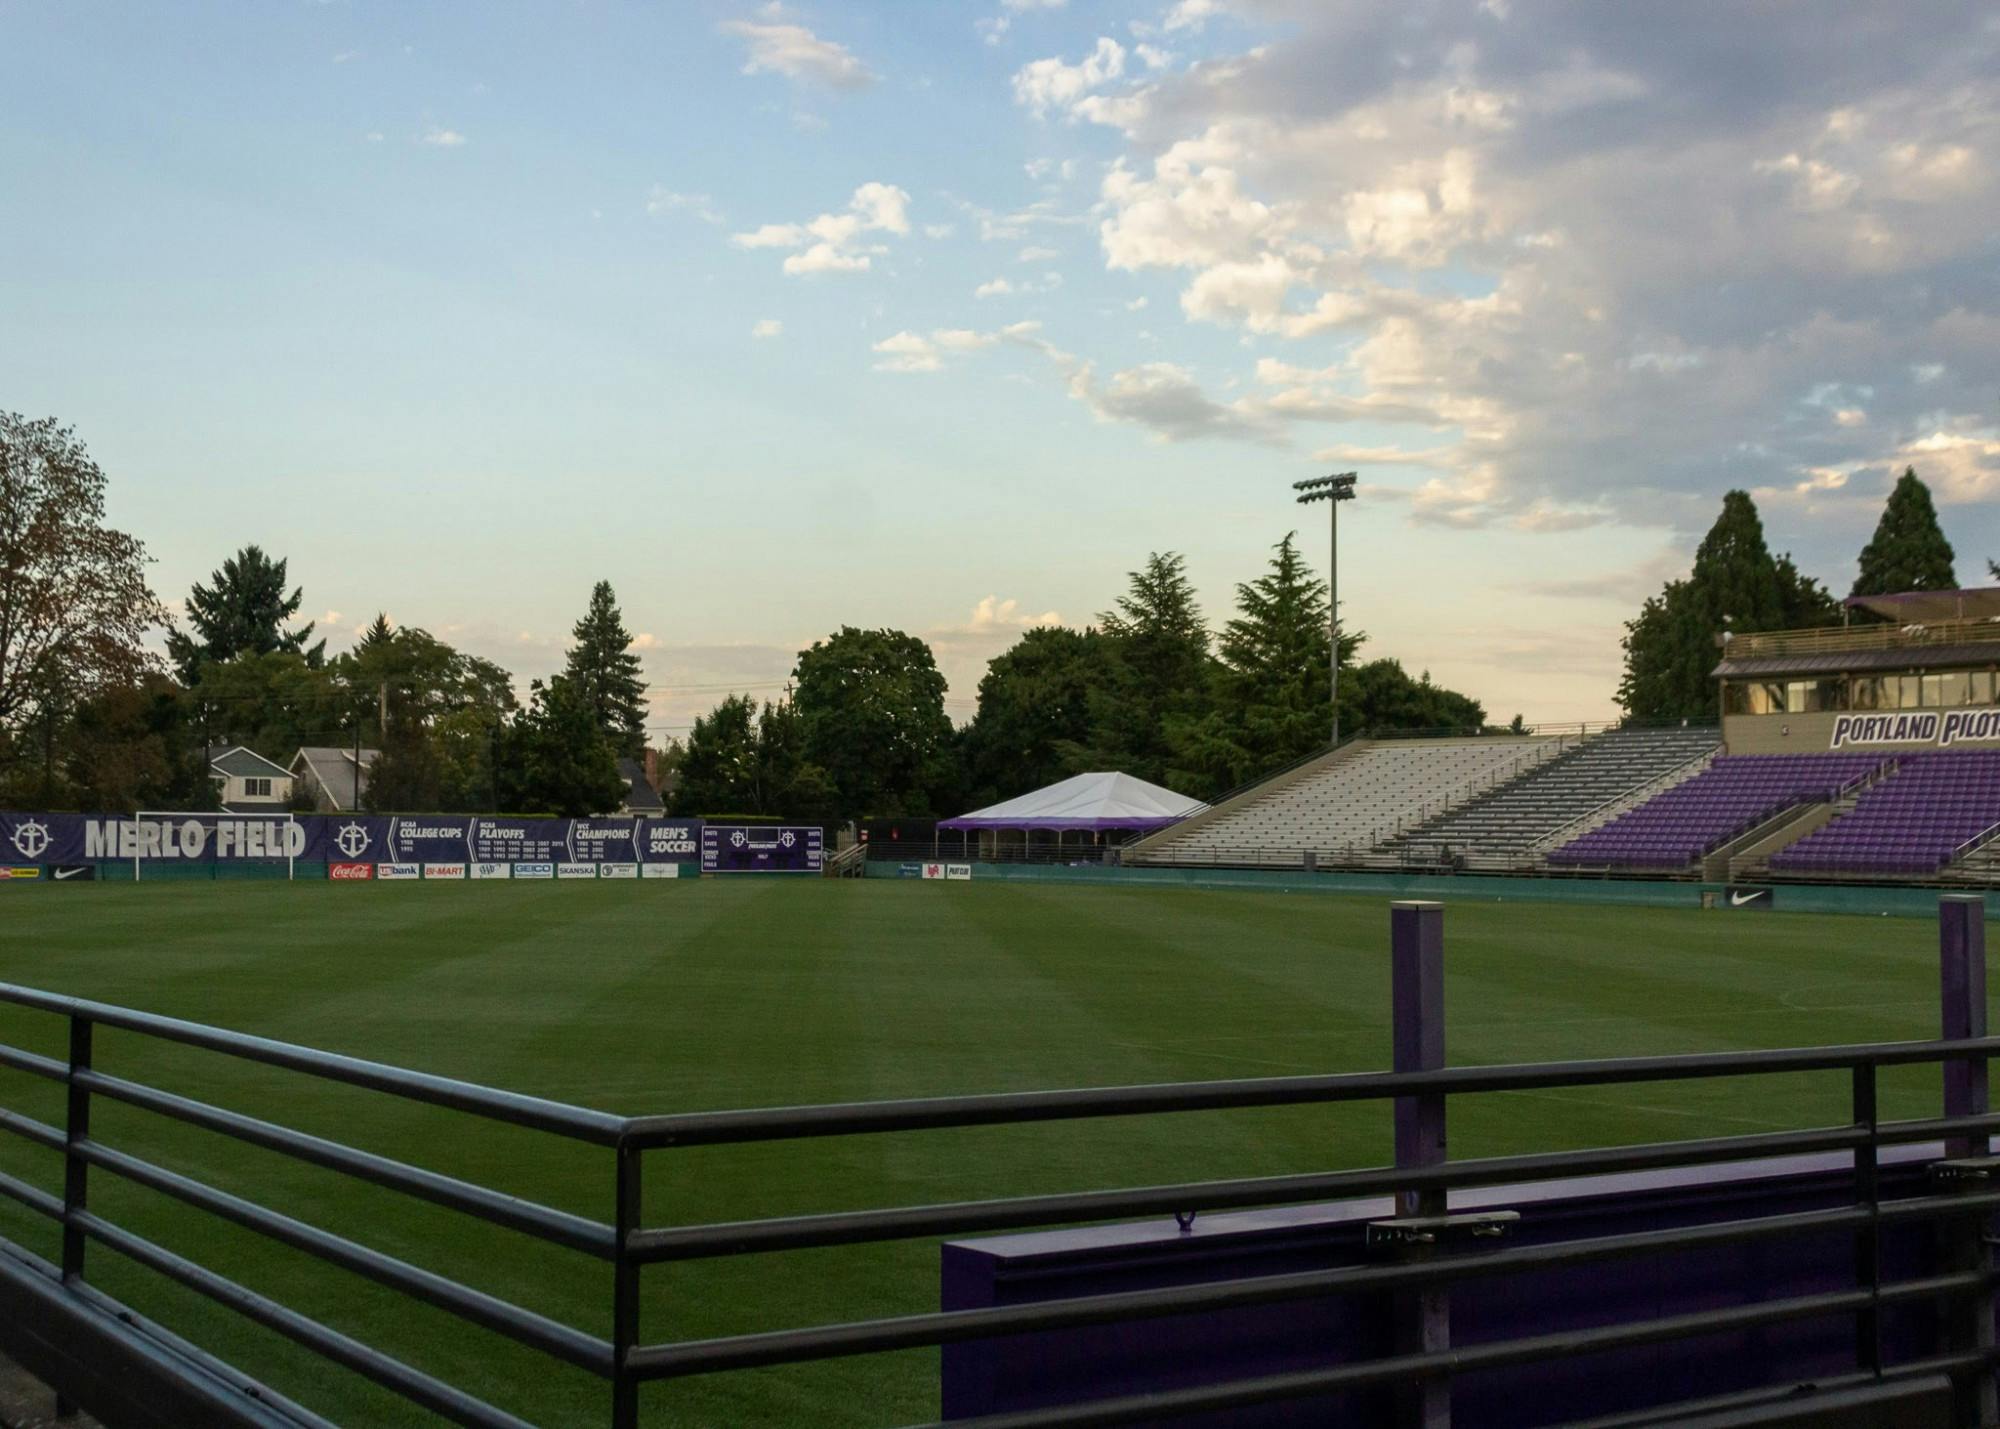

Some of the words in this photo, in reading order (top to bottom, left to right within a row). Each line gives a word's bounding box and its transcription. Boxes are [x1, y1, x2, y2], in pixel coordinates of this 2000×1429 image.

[1832, 714, 1938, 747] PORTLAND
[1940, 711, 2000, 745] PILOT
[400, 828, 438, 838] COLLEGE
[439, 828, 462, 838] CUPS
[480, 828, 525, 839] PLAYOFFS
[576, 829, 630, 839] CHAMPIONS
[650, 827, 688, 839] MEN'S
[85, 820, 205, 858] MERLO
[217, 821, 305, 857] FIELD
[650, 841, 696, 853] SOCCER
[426, 867, 464, 875] BI-MART
[516, 865, 550, 873] GEICO
